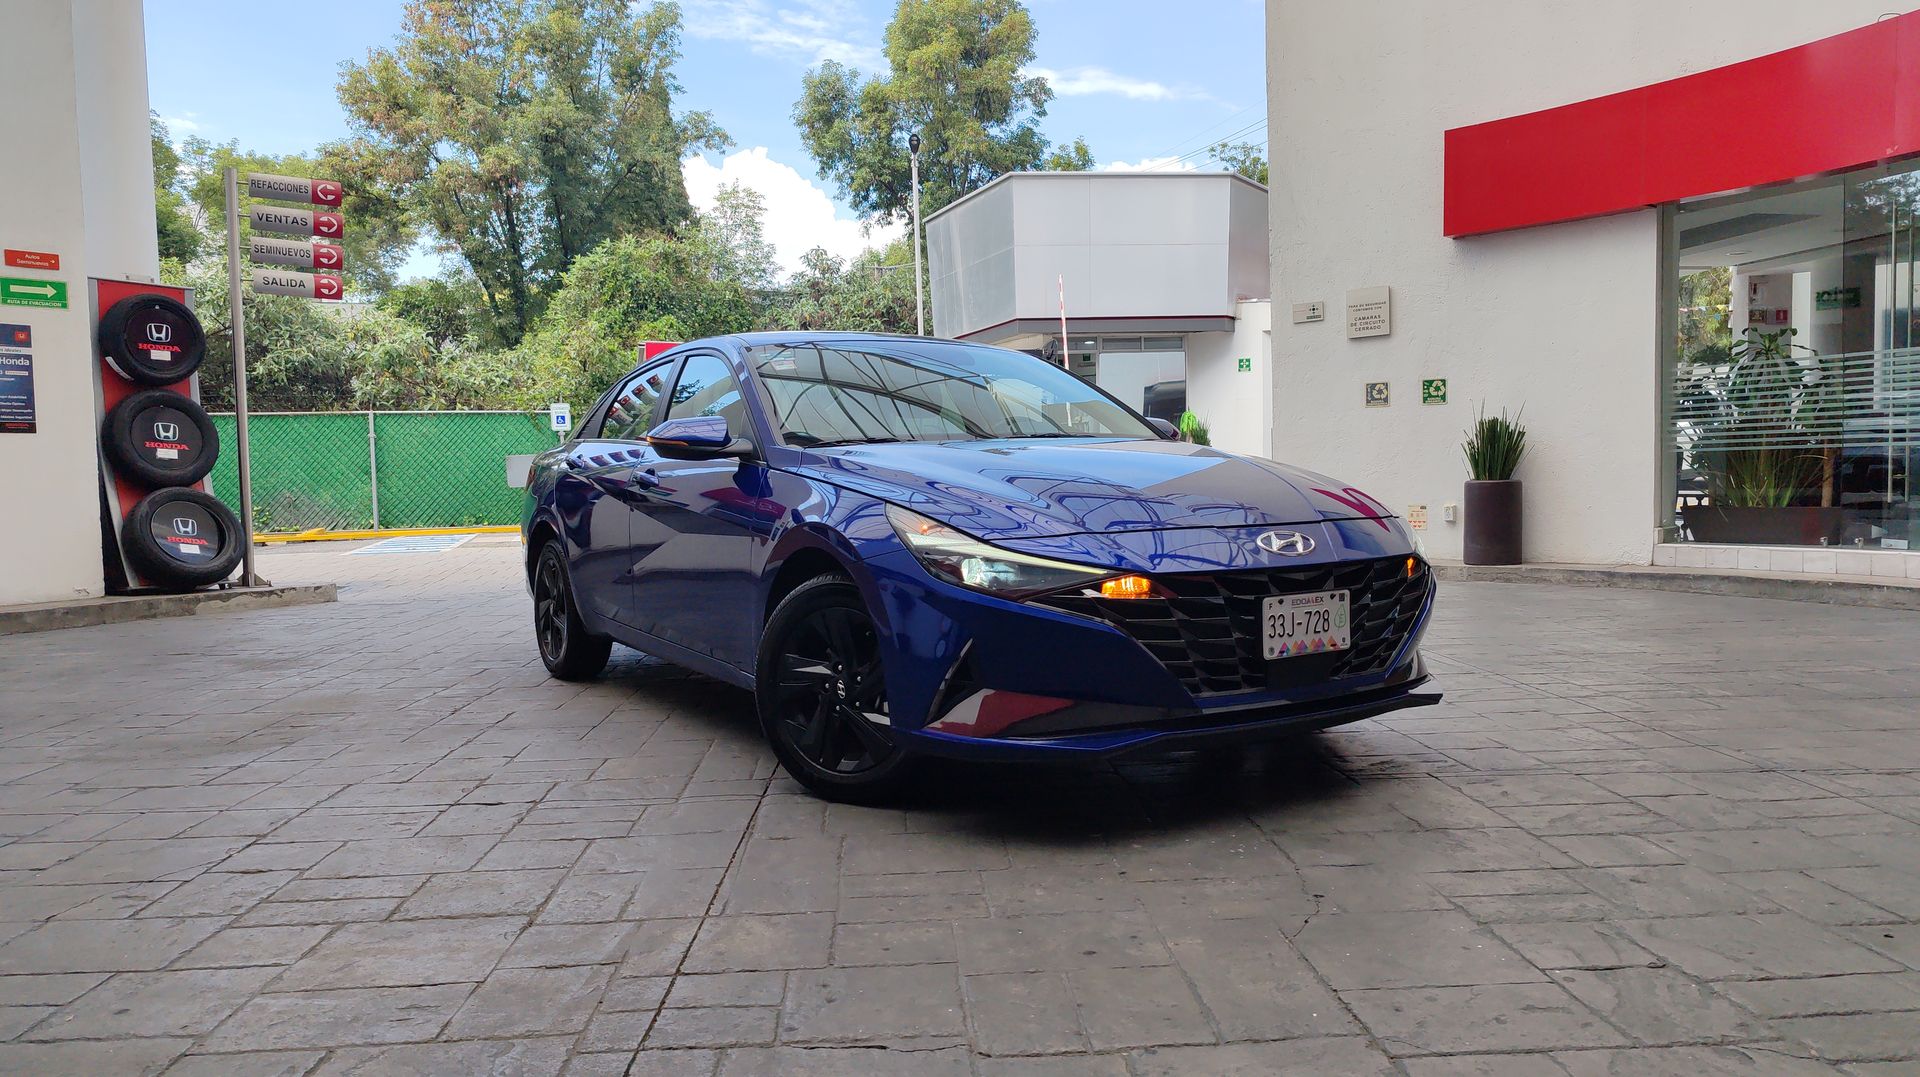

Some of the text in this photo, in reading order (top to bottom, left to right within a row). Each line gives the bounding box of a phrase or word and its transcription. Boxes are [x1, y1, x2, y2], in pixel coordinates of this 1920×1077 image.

[250, 179, 309, 194] REFACCIONES
[256, 212, 308, 227] VENTAS
[253, 244, 311, 259] SEMINUEVOS
[16, 258, 49, 267] Seminuevos
[262, 276, 306, 289] SALIDA
[1355, 324, 1382, 332] CERRADO
[138, 343, 181, 353] HONDA
[0, 356, 30, 366] Honda
[144, 441, 190, 451] HONDA
[166, 536, 209, 545] HONDA
[1268, 609, 1330, 639] 33J-728
